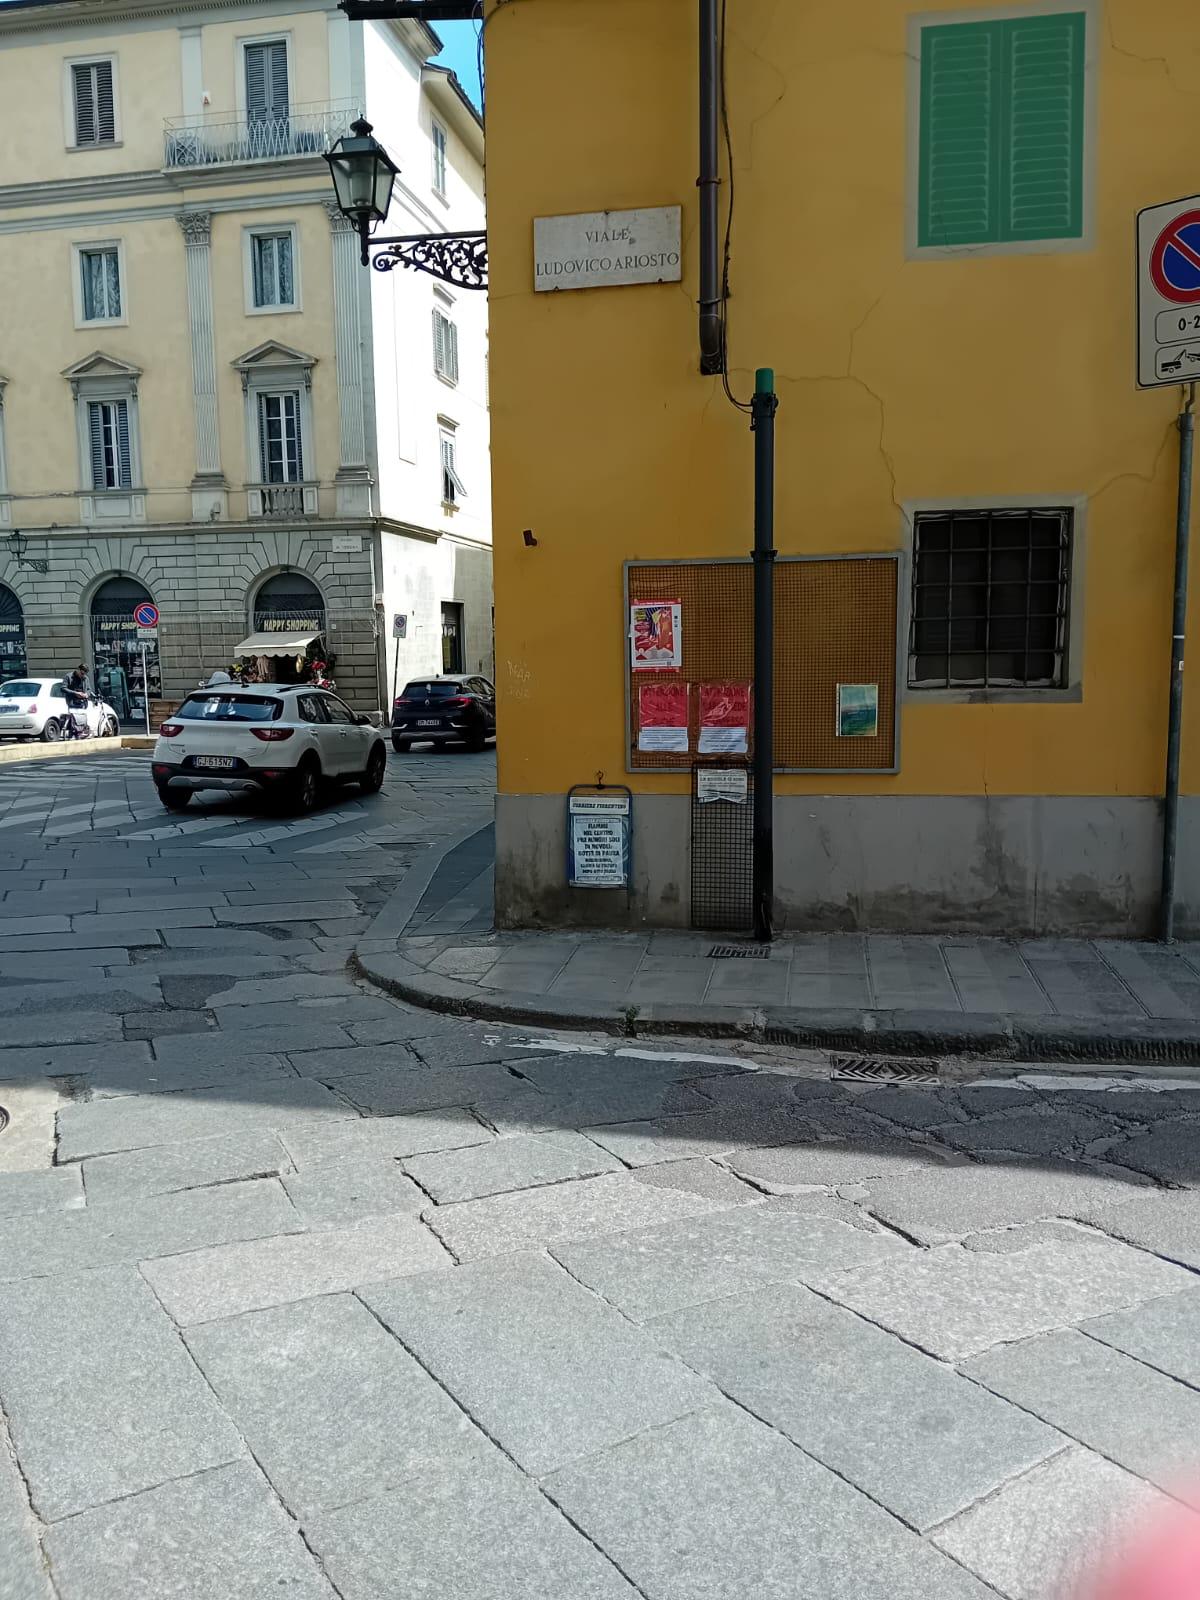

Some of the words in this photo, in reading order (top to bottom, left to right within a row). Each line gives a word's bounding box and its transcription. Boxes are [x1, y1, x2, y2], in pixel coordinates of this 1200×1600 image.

[585, 228, 630, 243] VIALE
[536, 258, 611, 276] LUDOVICO
[614, 252, 680, 271] ARIOSTO
[100, 622, 120, 631] HAPPY
[121, 622, 139, 630] SHOP
[264, 619, 285, 631] HAPPY
[286, 619, 319, 631] SHOPPING
